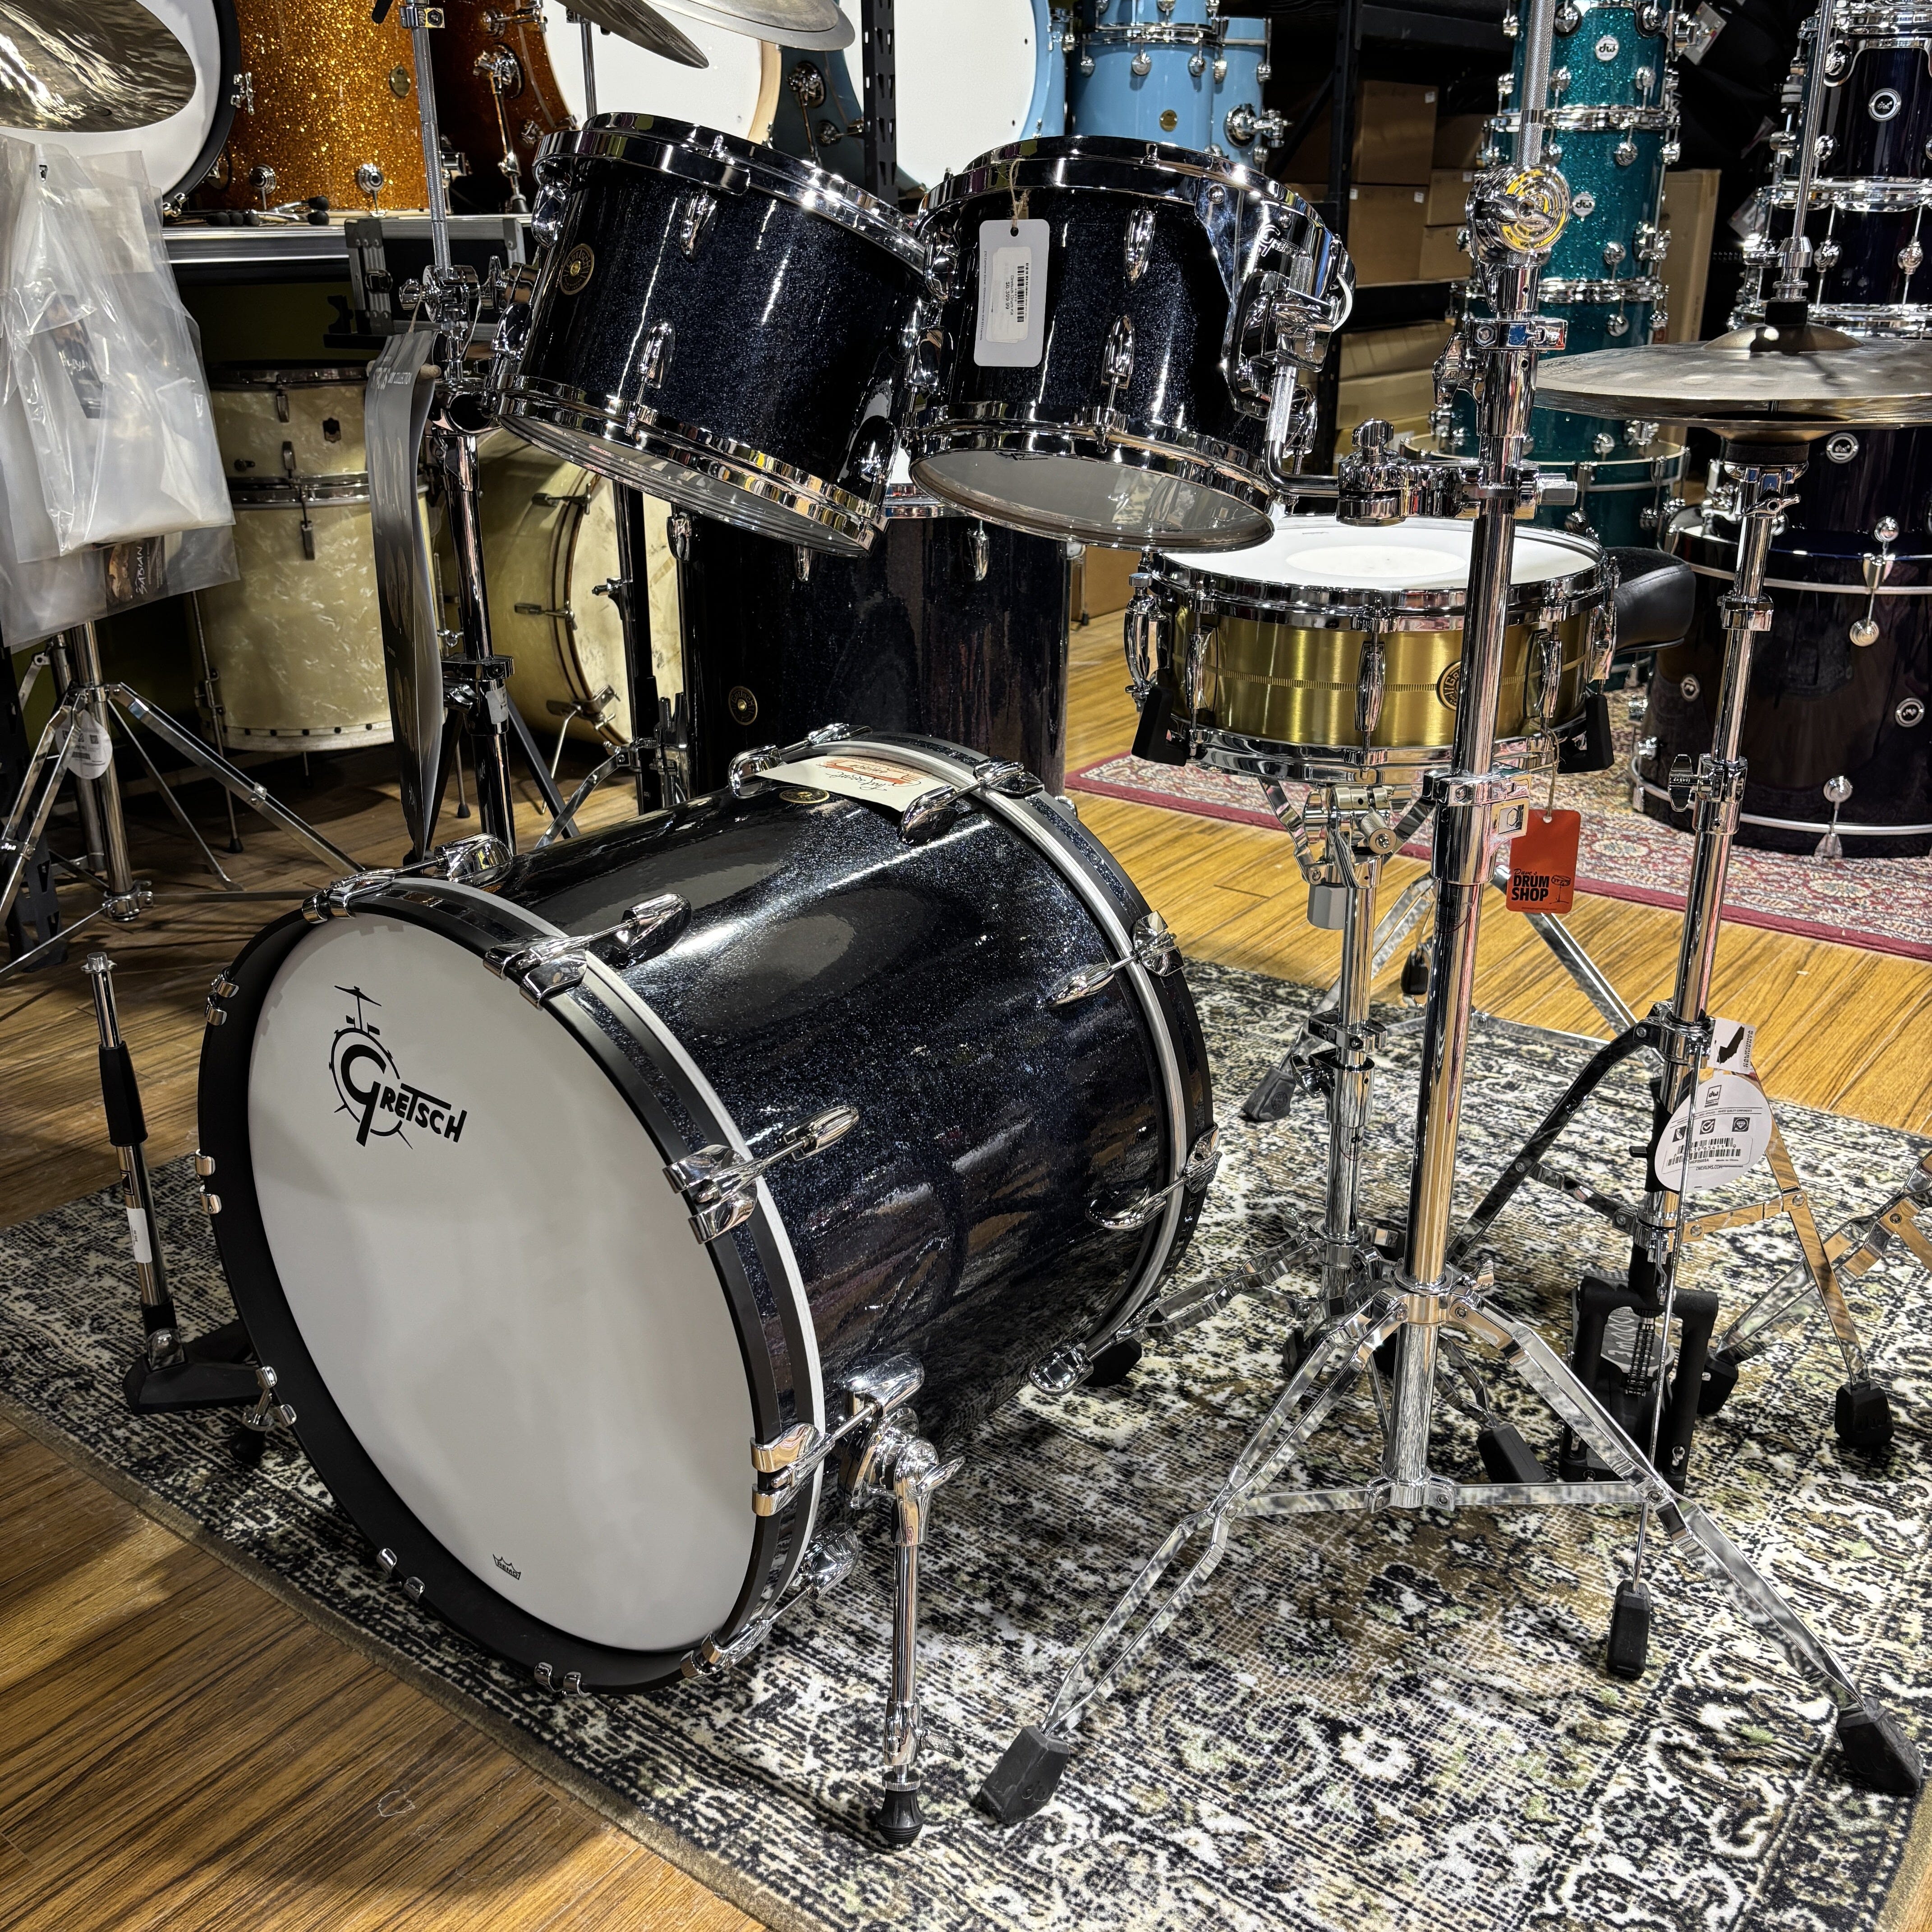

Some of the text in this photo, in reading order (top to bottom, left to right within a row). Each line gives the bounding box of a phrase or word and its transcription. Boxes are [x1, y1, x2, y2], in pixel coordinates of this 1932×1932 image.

[135, 547, 148, 595] SABIAN
[1512, 887, 1549, 902] SHOP
[1513, 875, 1550, 888] DRUM
[341, 1044, 467, 1147] GRETSCH
